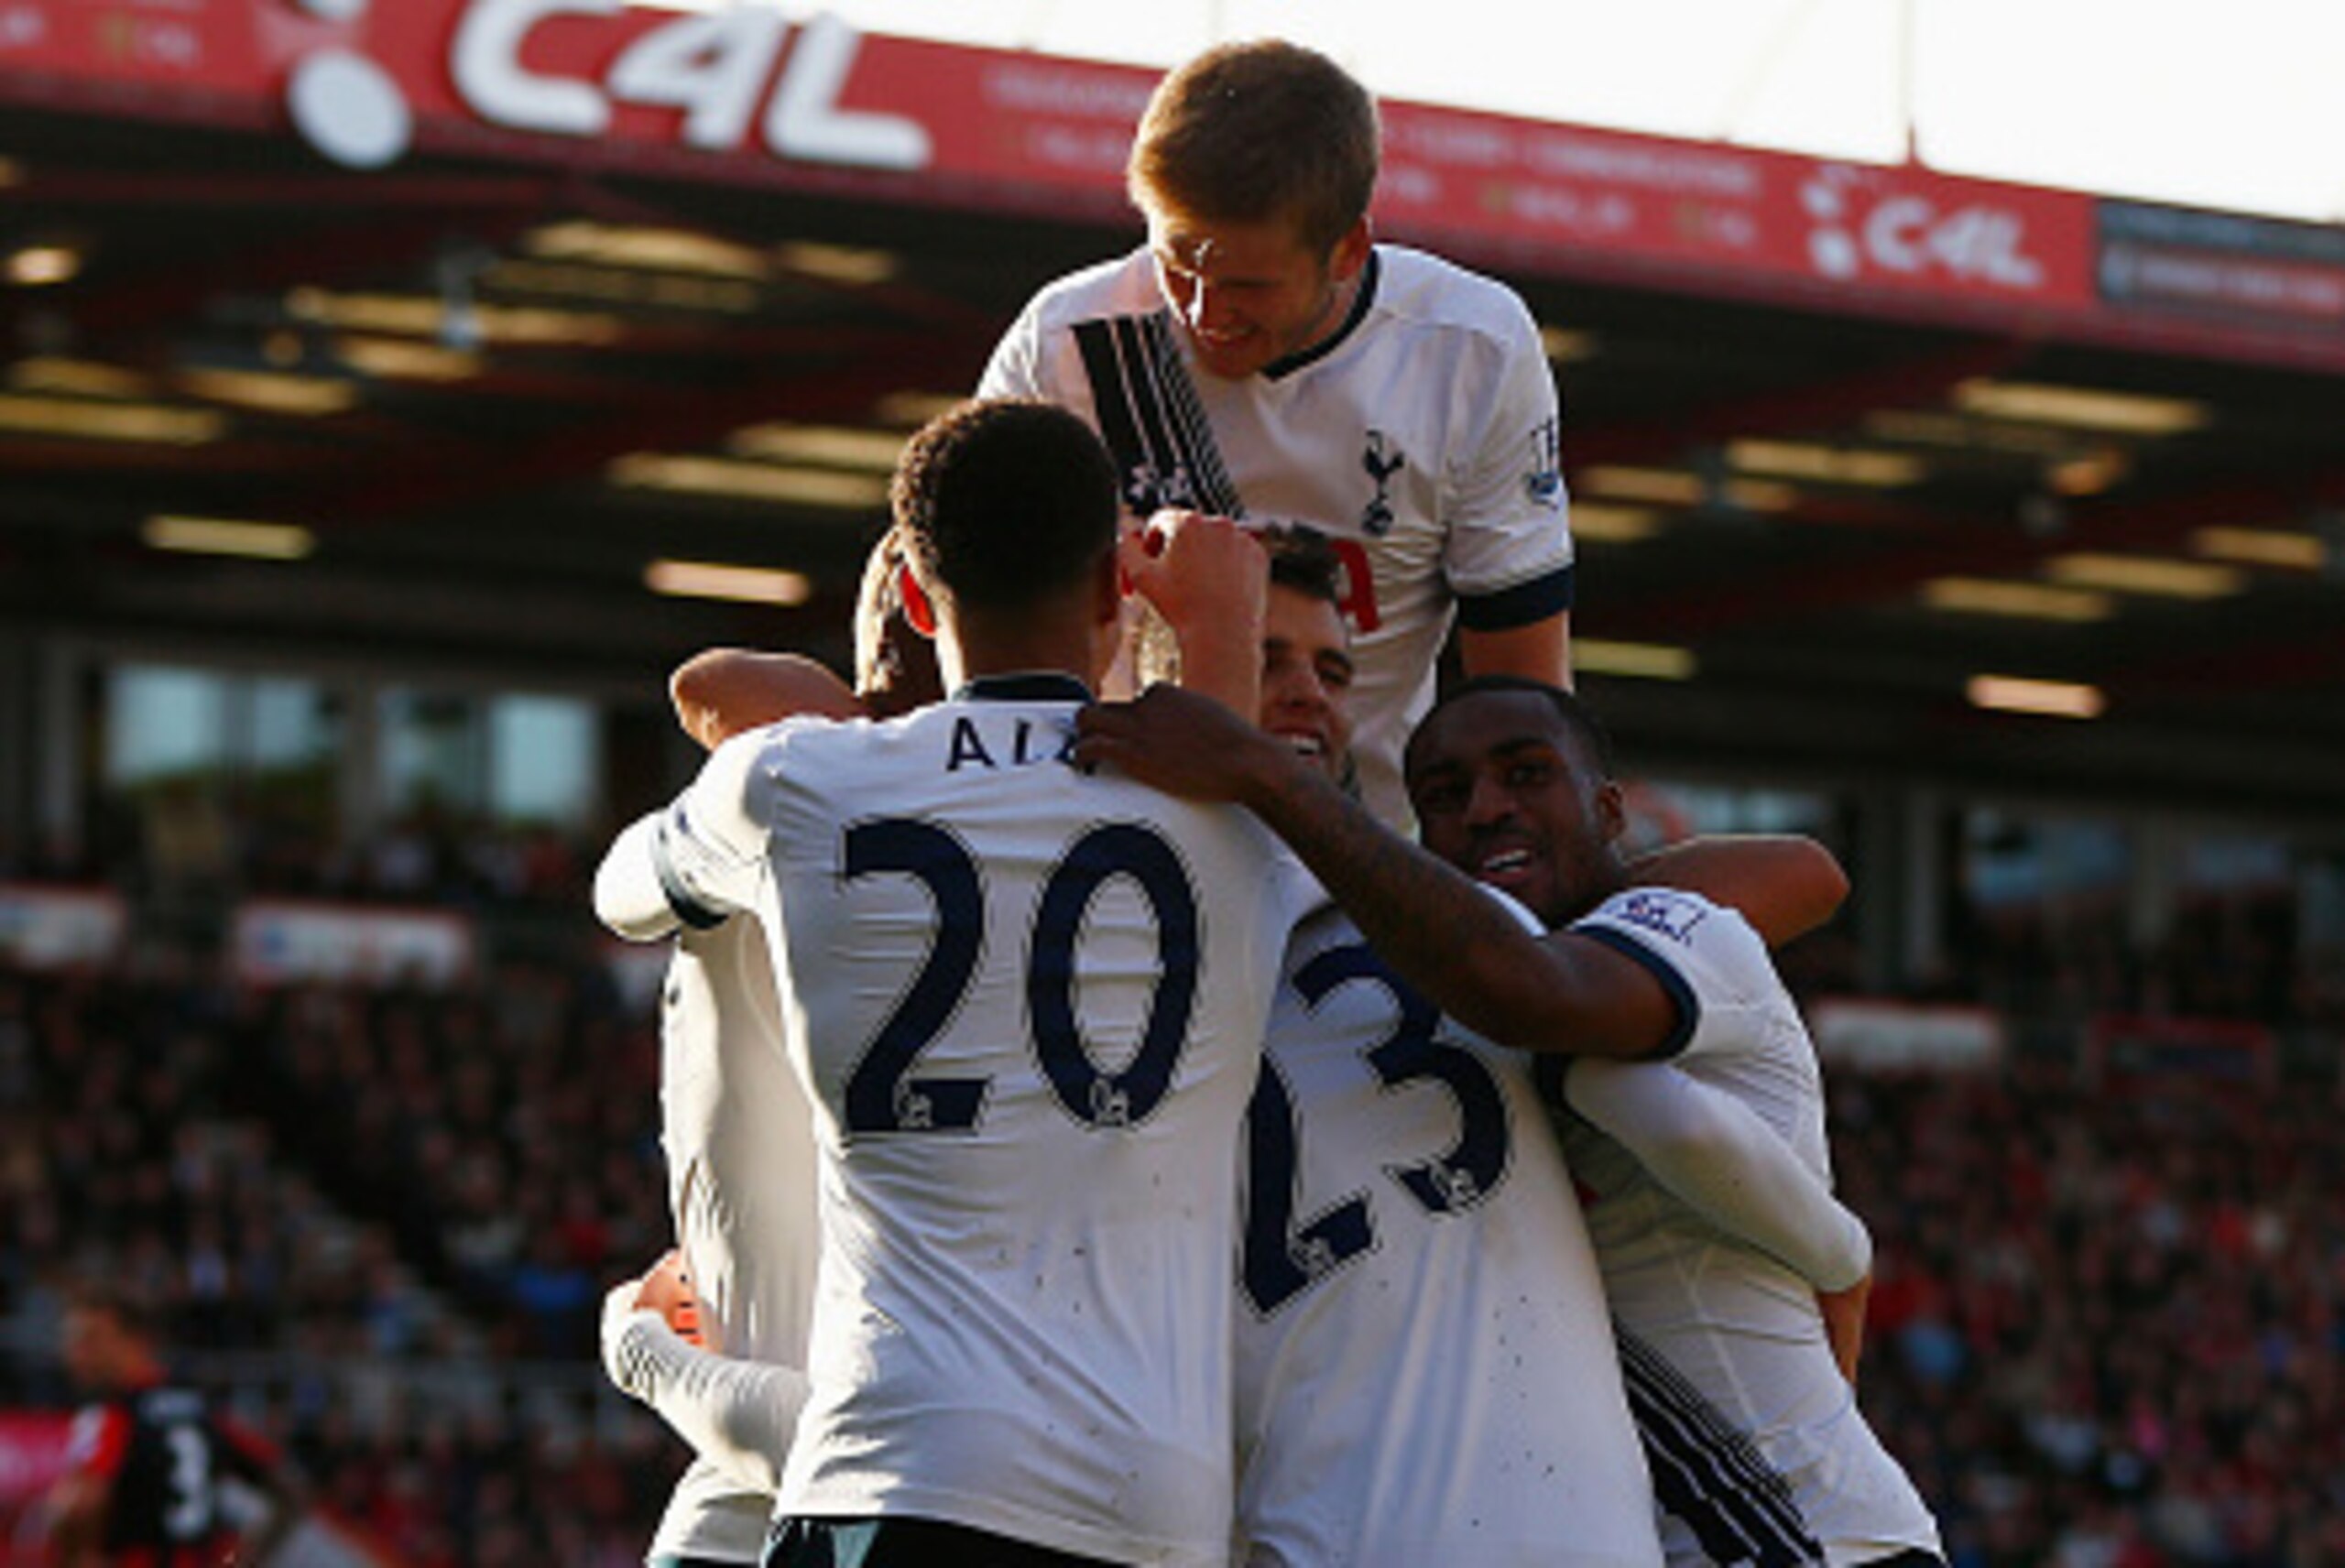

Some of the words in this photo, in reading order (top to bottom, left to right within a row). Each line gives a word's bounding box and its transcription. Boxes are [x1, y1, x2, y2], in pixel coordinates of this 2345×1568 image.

[449, 0, 934, 171] C4L
[1863, 194, 2047, 287] C4L
[837, 817, 1205, 1138] 20
[1234, 943, 1517, 1321] 23
